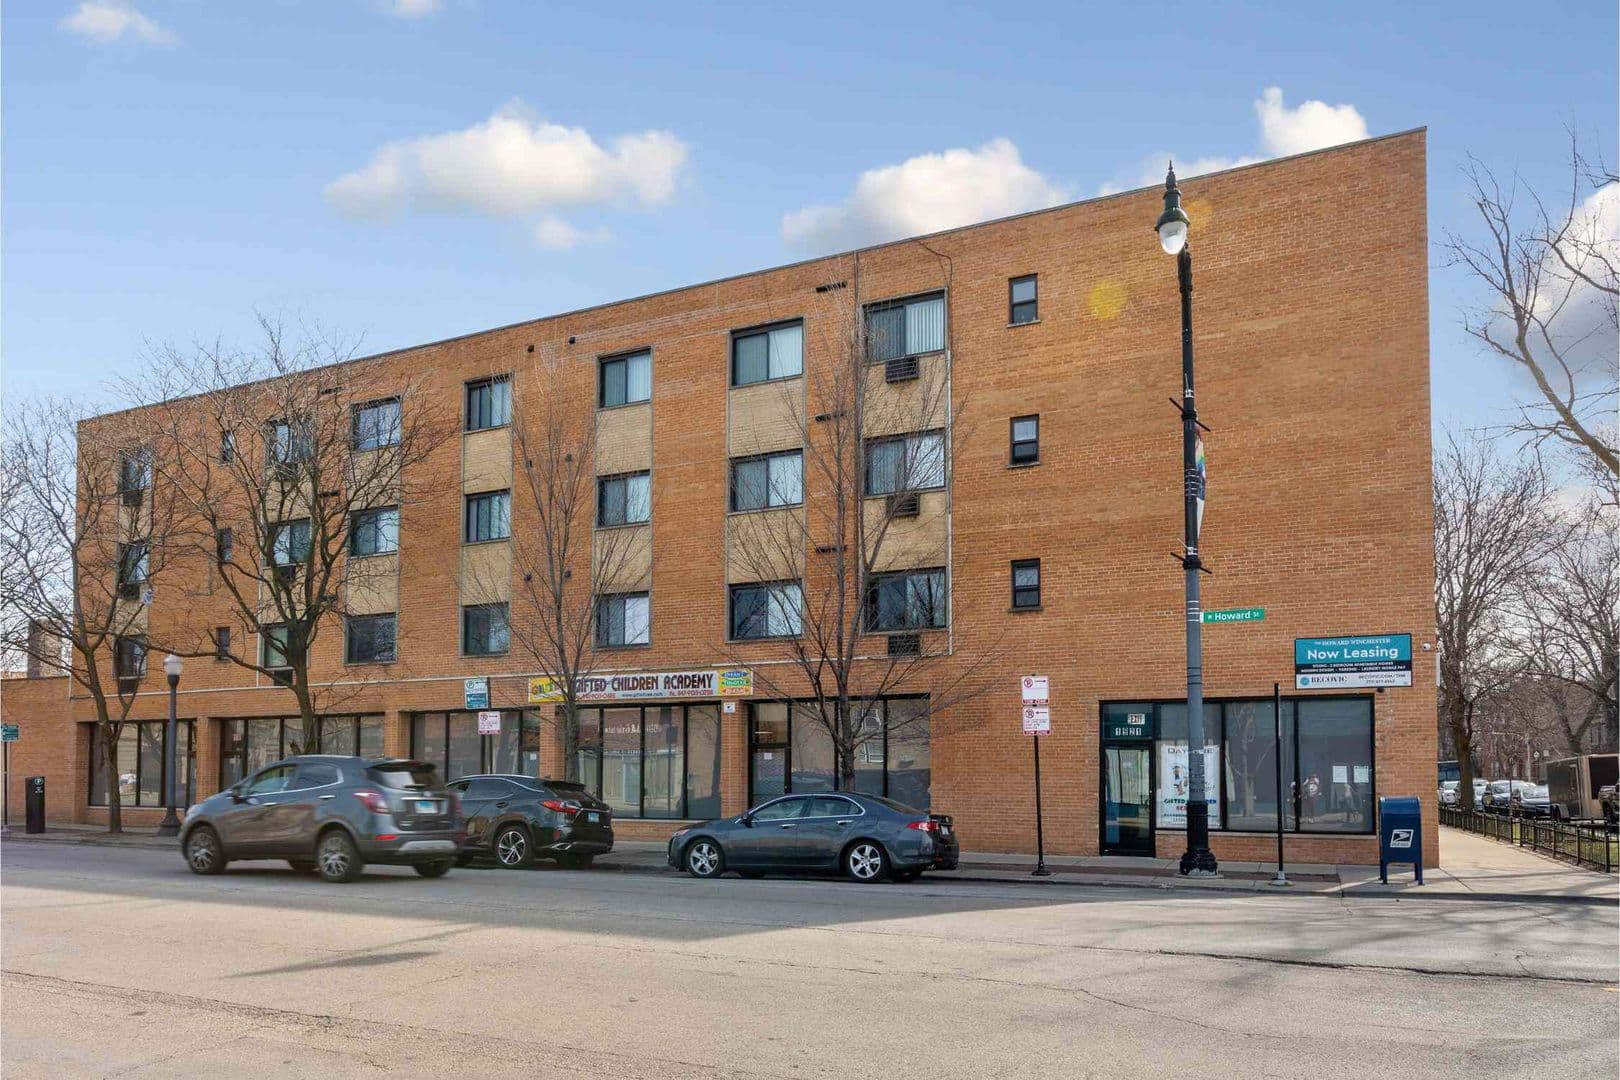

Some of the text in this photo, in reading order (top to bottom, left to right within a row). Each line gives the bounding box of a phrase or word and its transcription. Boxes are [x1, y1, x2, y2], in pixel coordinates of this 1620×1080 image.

[1214, 611, 1250, 620] Howard
[1307, 646, 1399, 660] Now Leasing
[575, 678, 607, 693] GIFTED
[611, 676, 659, 691] CHILDREN
[664, 673, 714, 690] ACADEMY
